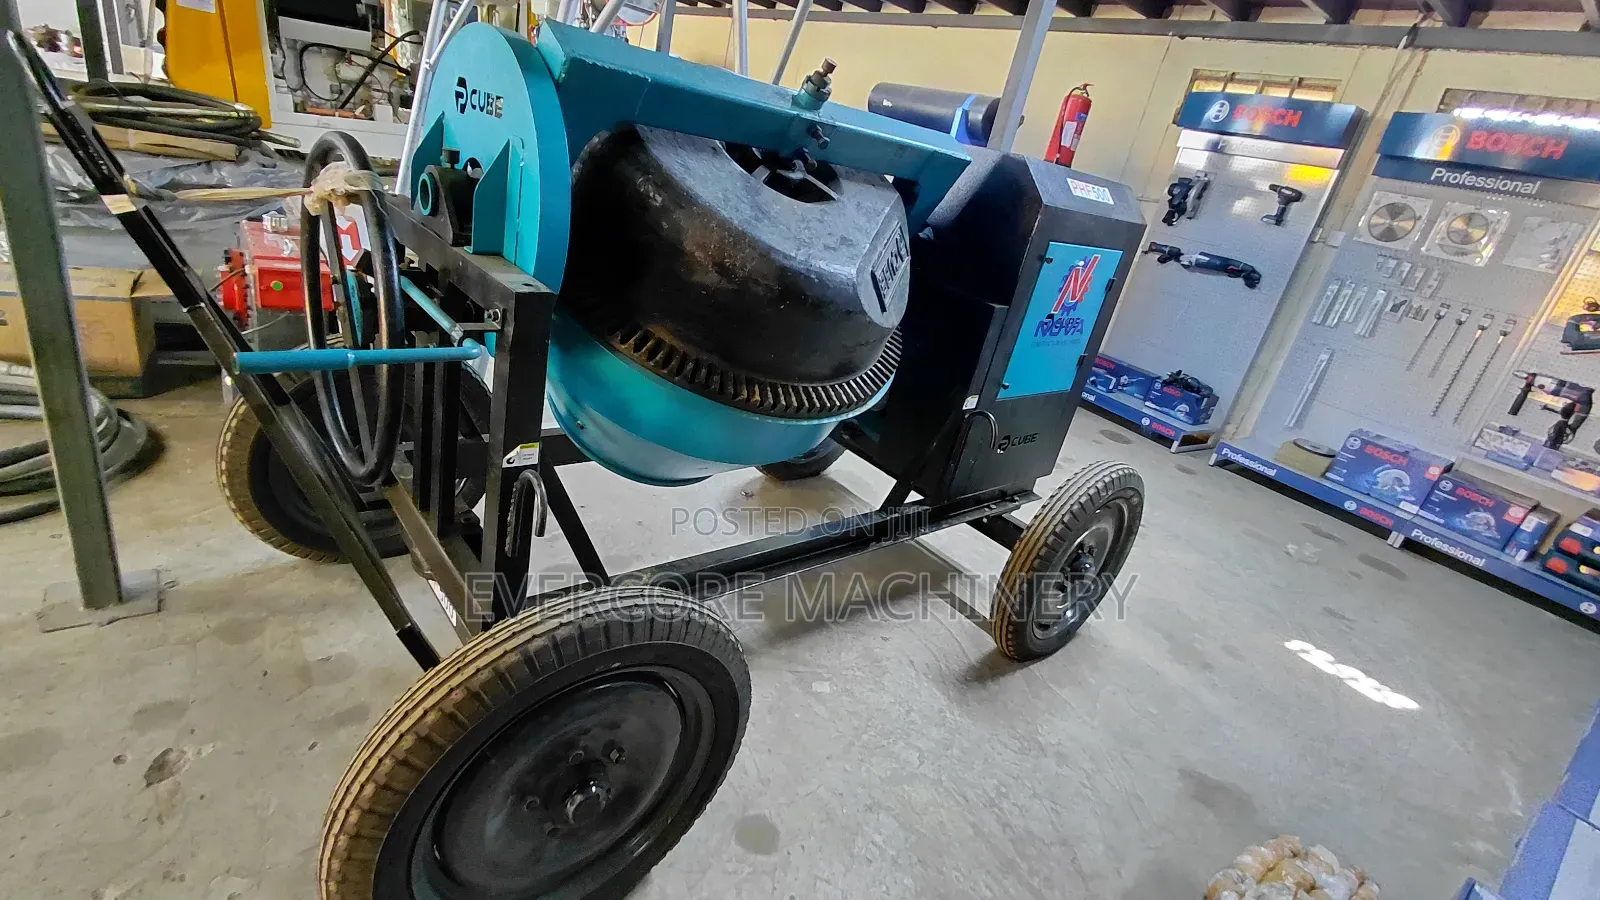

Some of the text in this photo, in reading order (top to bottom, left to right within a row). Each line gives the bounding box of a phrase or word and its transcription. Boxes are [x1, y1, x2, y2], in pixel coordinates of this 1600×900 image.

[1232, 104, 1303, 127] BOSCH
[1465, 130, 1568, 160] BOSCH
[1430, 167, 1541, 195] Professional
[1151, 421, 1175, 437] BOSCH
[1221, 447, 1277, 477] Professional
[1364, 444, 1408, 466] BOSCH
[1456, 486, 1495, 508] BOSCH
[1359, 507, 1394, 527] BOSCH
[1411, 528, 1487, 567] Professional
